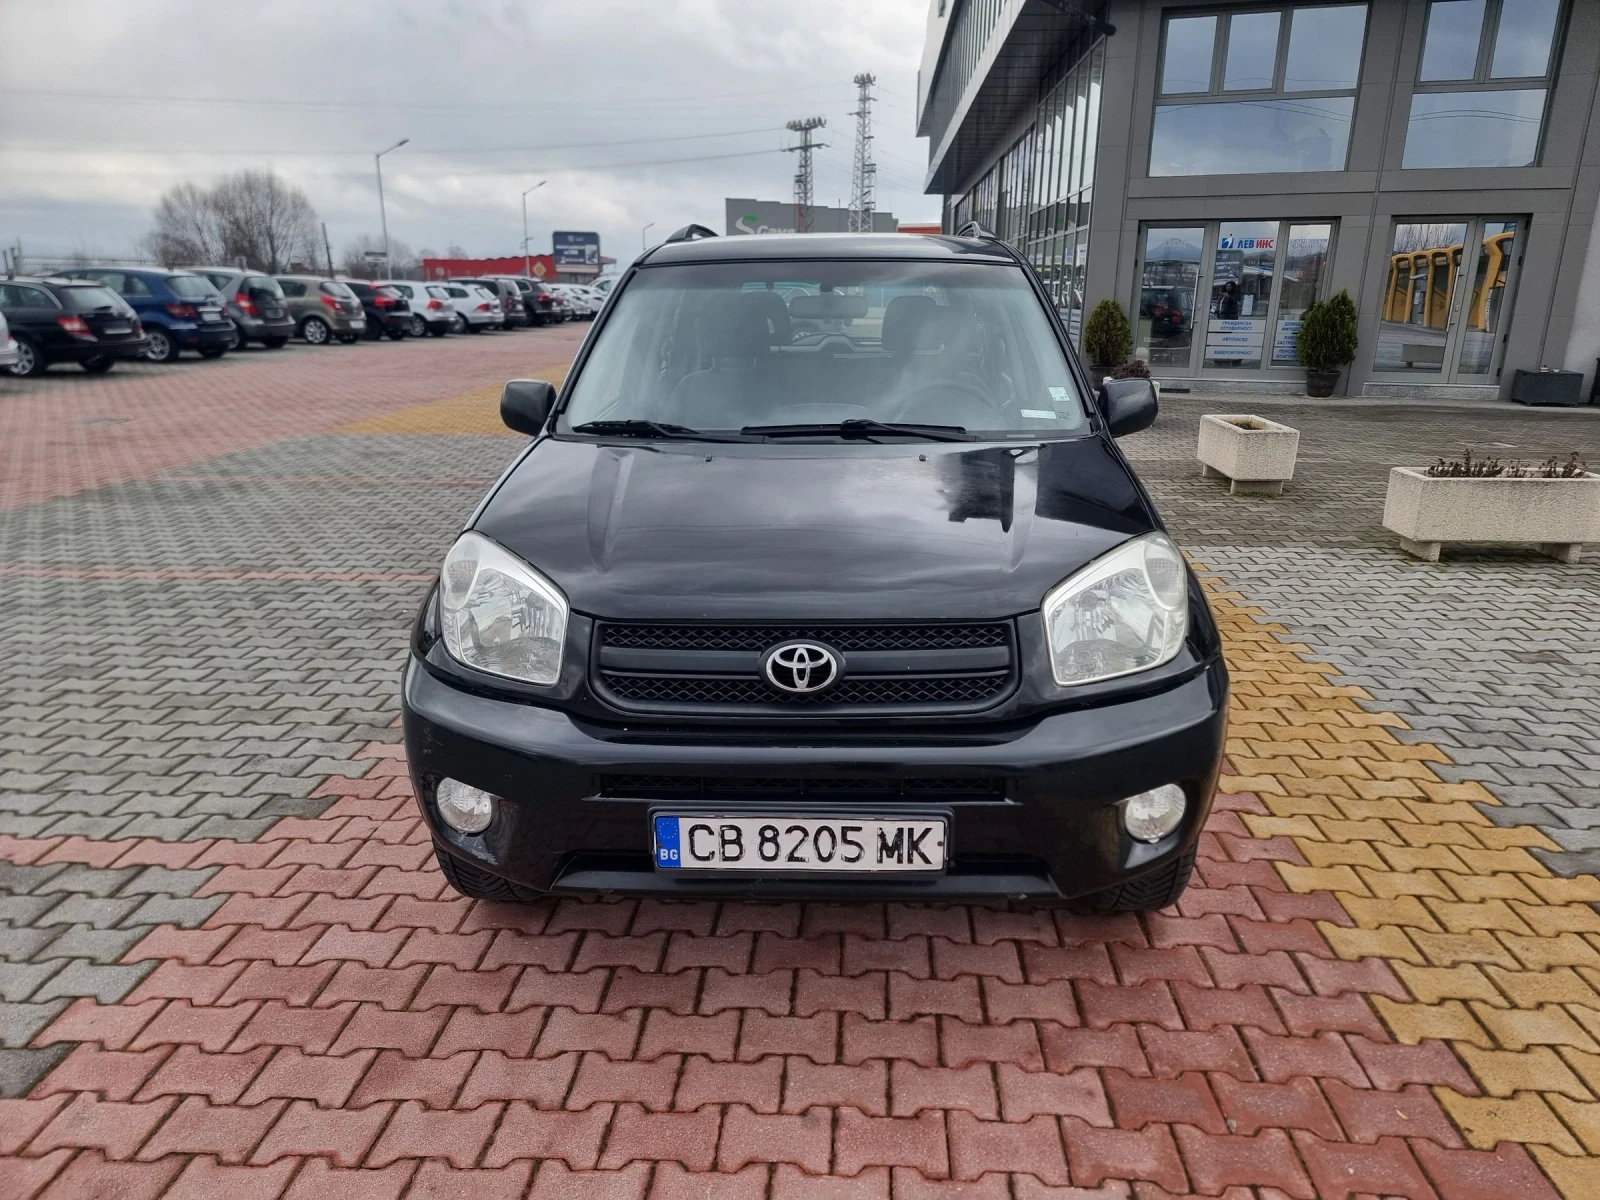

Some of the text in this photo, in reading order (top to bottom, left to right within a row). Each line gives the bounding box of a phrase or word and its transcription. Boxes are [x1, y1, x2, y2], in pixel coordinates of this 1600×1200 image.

[1237, 239, 1274, 249] ЛЕВ ИНС
[660, 824, 934, 865] BG CB 8205 MK
